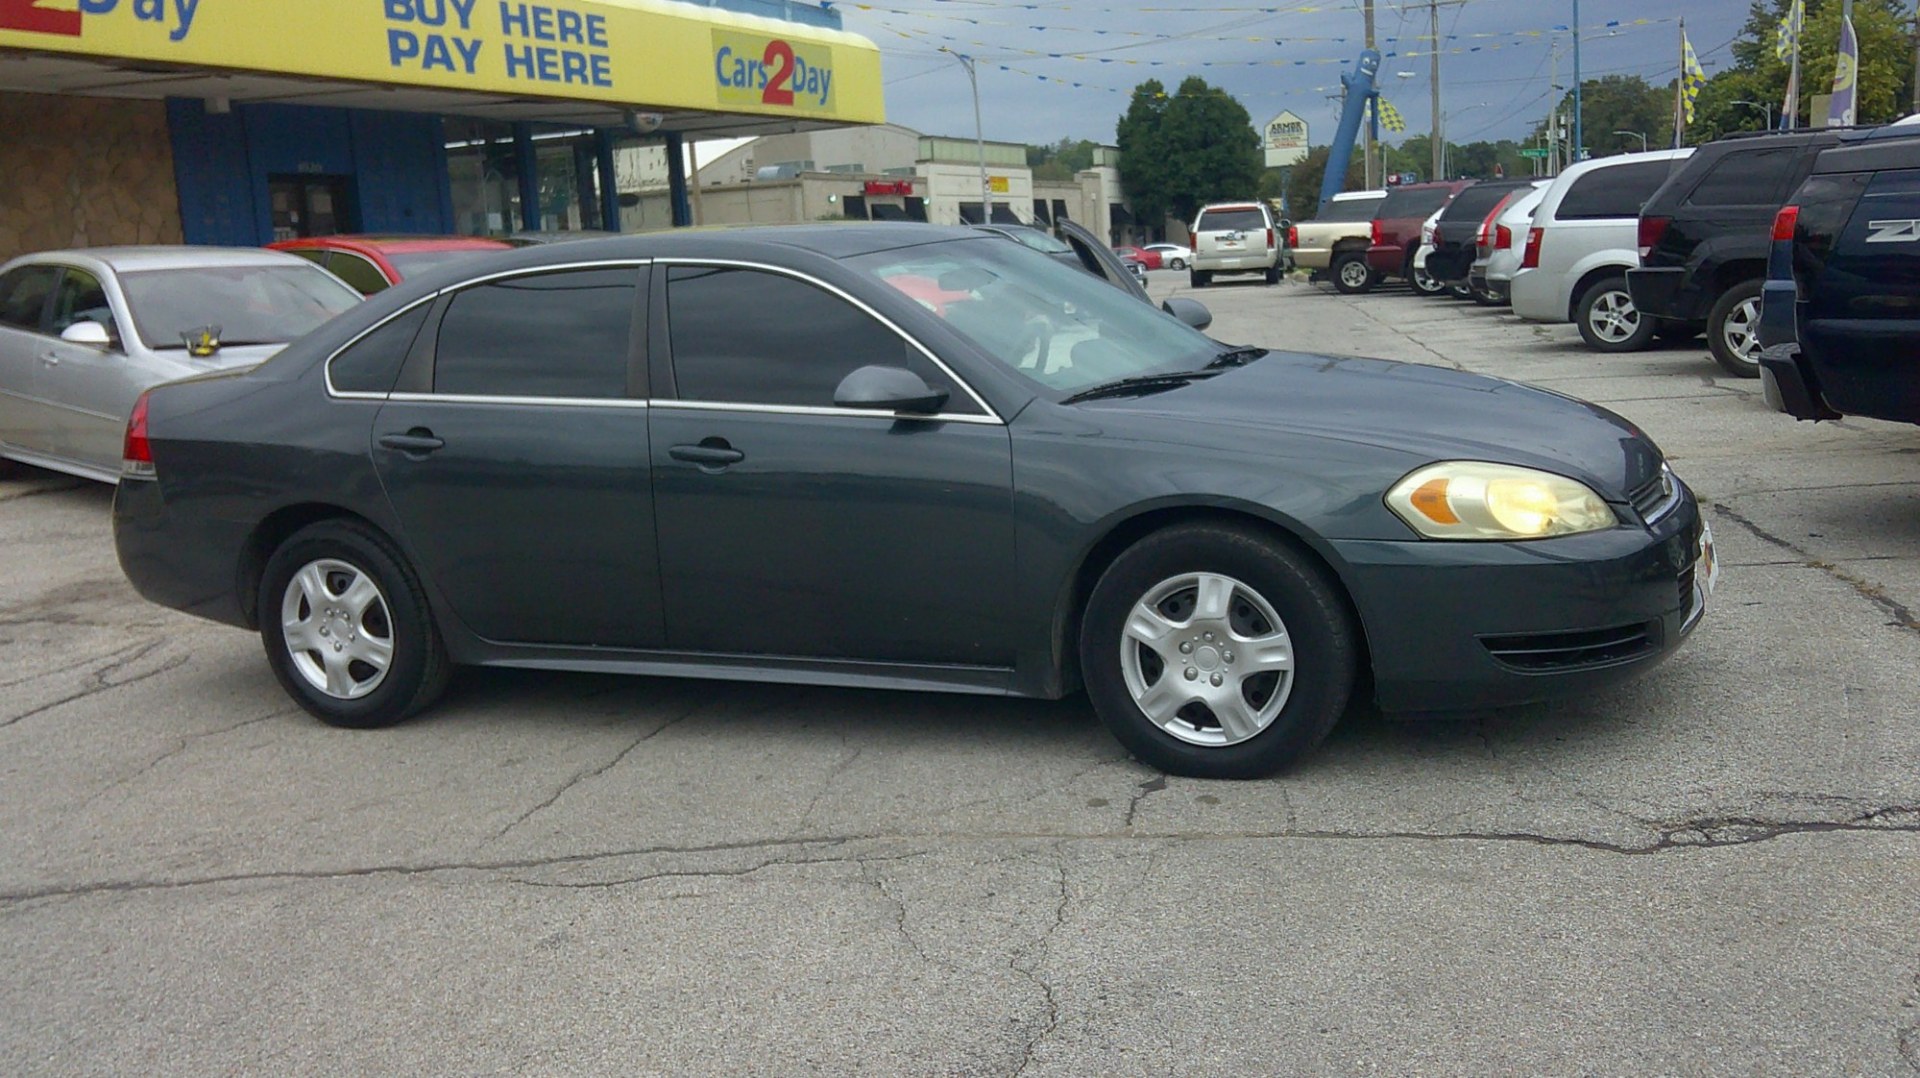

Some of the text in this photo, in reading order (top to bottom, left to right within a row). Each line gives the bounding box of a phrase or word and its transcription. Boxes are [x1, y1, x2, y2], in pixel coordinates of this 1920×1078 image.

[384, 0, 609, 48] BUY HERE
[386, 28, 613, 87] PAY HERE
[1866, 219, 1920, 242] Z
